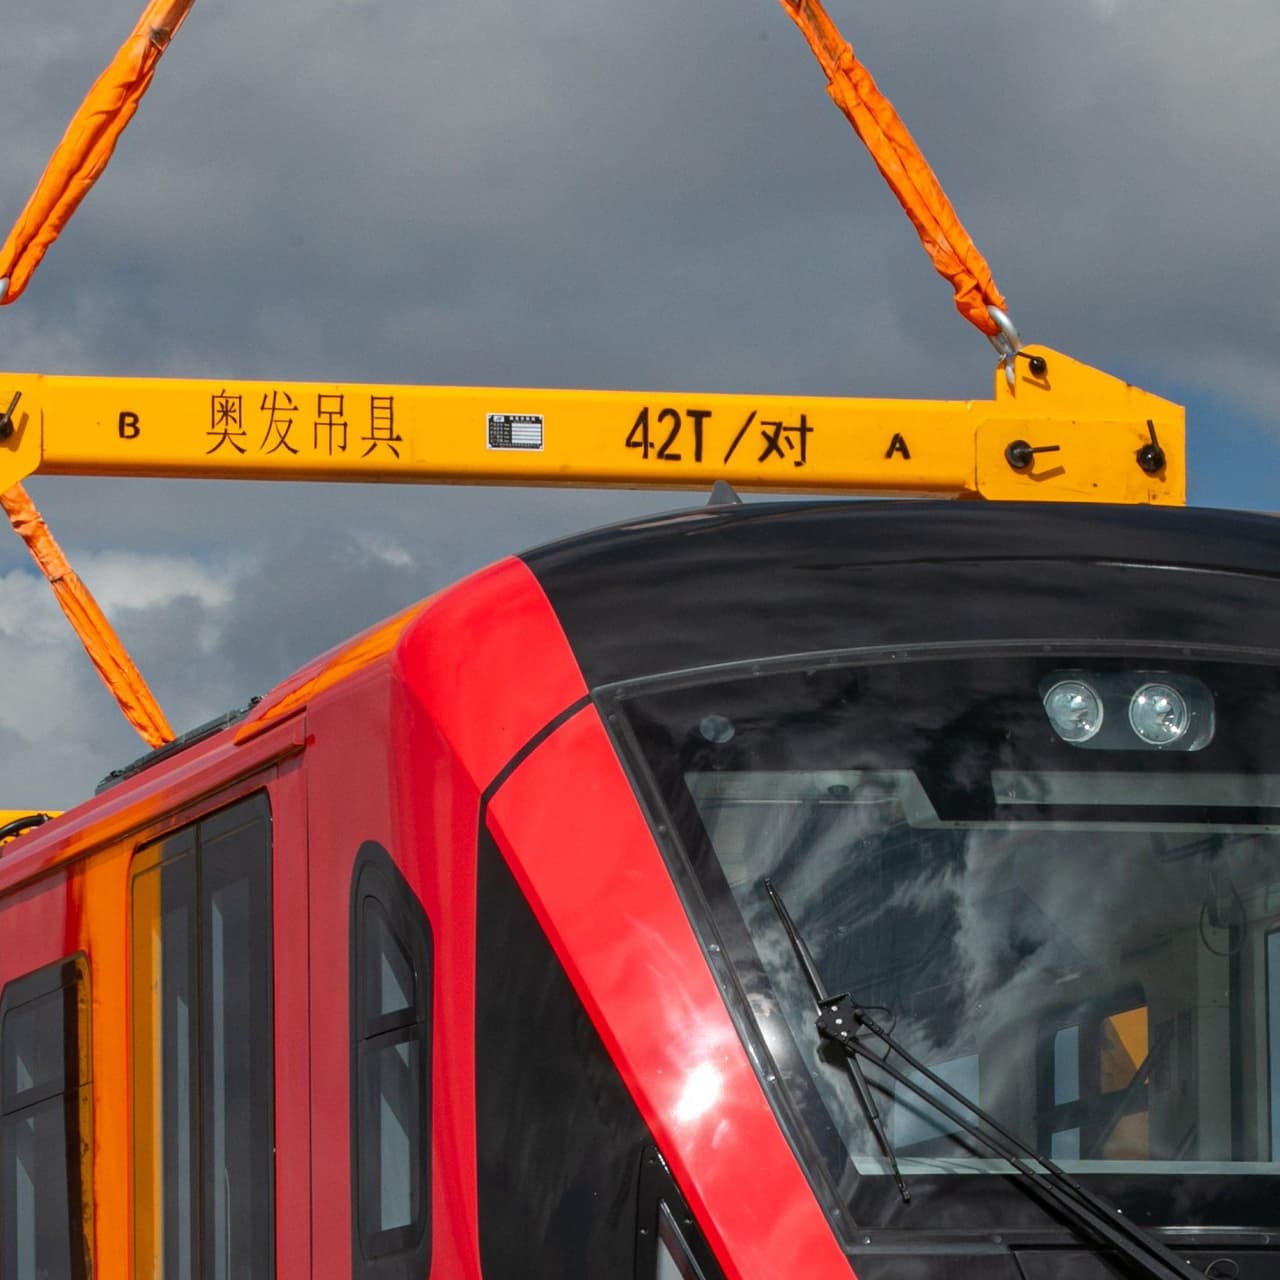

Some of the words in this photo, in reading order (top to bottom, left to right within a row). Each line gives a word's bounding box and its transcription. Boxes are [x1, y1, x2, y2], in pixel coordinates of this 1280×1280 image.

[118, 411, 141, 438] B
[205, 389, 404, 459] 奥发吊具
[884, 432, 911, 459] A
